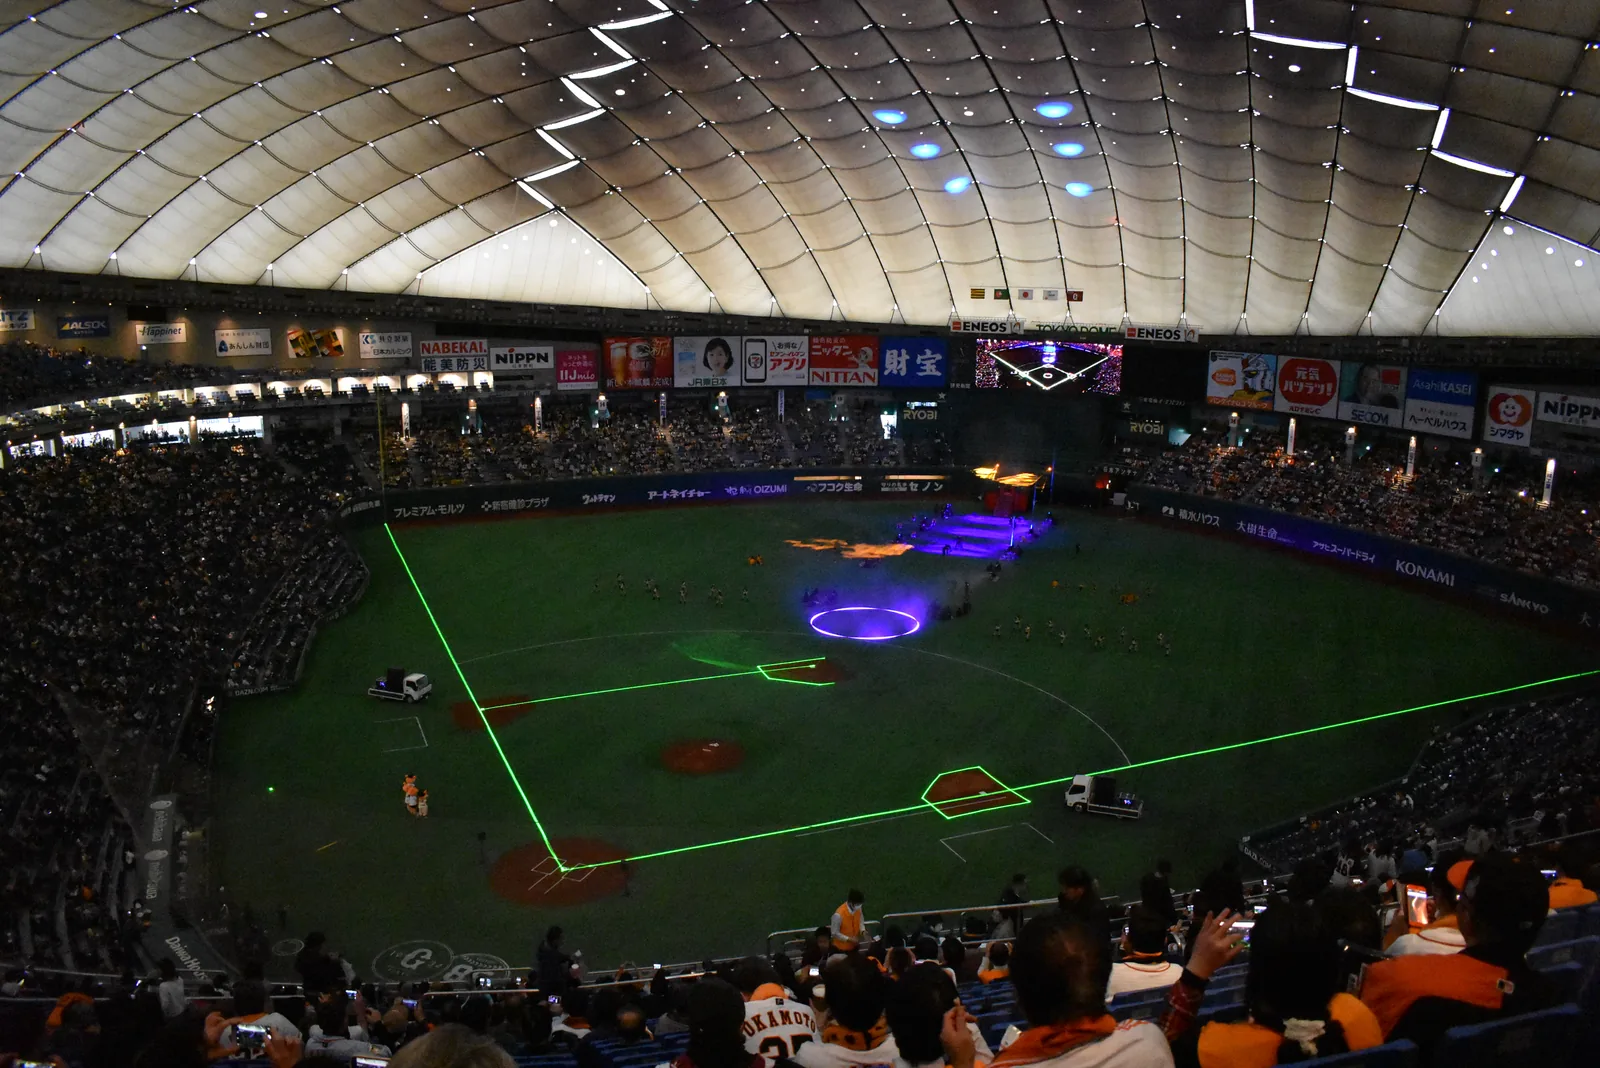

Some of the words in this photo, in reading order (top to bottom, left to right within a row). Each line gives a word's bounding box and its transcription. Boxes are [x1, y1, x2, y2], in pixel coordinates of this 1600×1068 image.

[70, 320, 107, 330] ALSOK
[963, 322, 1007, 332] ENEOS
[1137, 328, 1181, 340] ENEOS
[229, 341, 270, 350] あんしん財団
[812, 344, 852, 356] ニッタン
[424, 358, 486, 371] 能美防災
[770, 358, 807, 371] アプリ
[884, 349, 942, 377] 財宝
[812, 371, 876, 383] NITTAN
[1295, 366, 1320, 381] 元気
[903, 410, 938, 420] RYOBI
[1351, 409, 1389, 425] SECOM
[1130, 421, 1164, 435] RYOBI
[1409, 415, 1467, 431] ヘーベルハウス
[1490, 426, 1524, 440] シマダヤ
[753, 485, 788, 494] OIZUMI
[818, 482, 863, 492] フコク生命
[648, 489, 712, 500] アートネイチャー
[1178, 508, 1220, 527] 積水ハウス
[1236, 520, 1278, 540] 大樹生命
[1395, 559, 1455, 587] KONAMI
[1499, 591, 1550, 614] SANKYO
[742, 1010, 816, 1038] OKAMOTO
